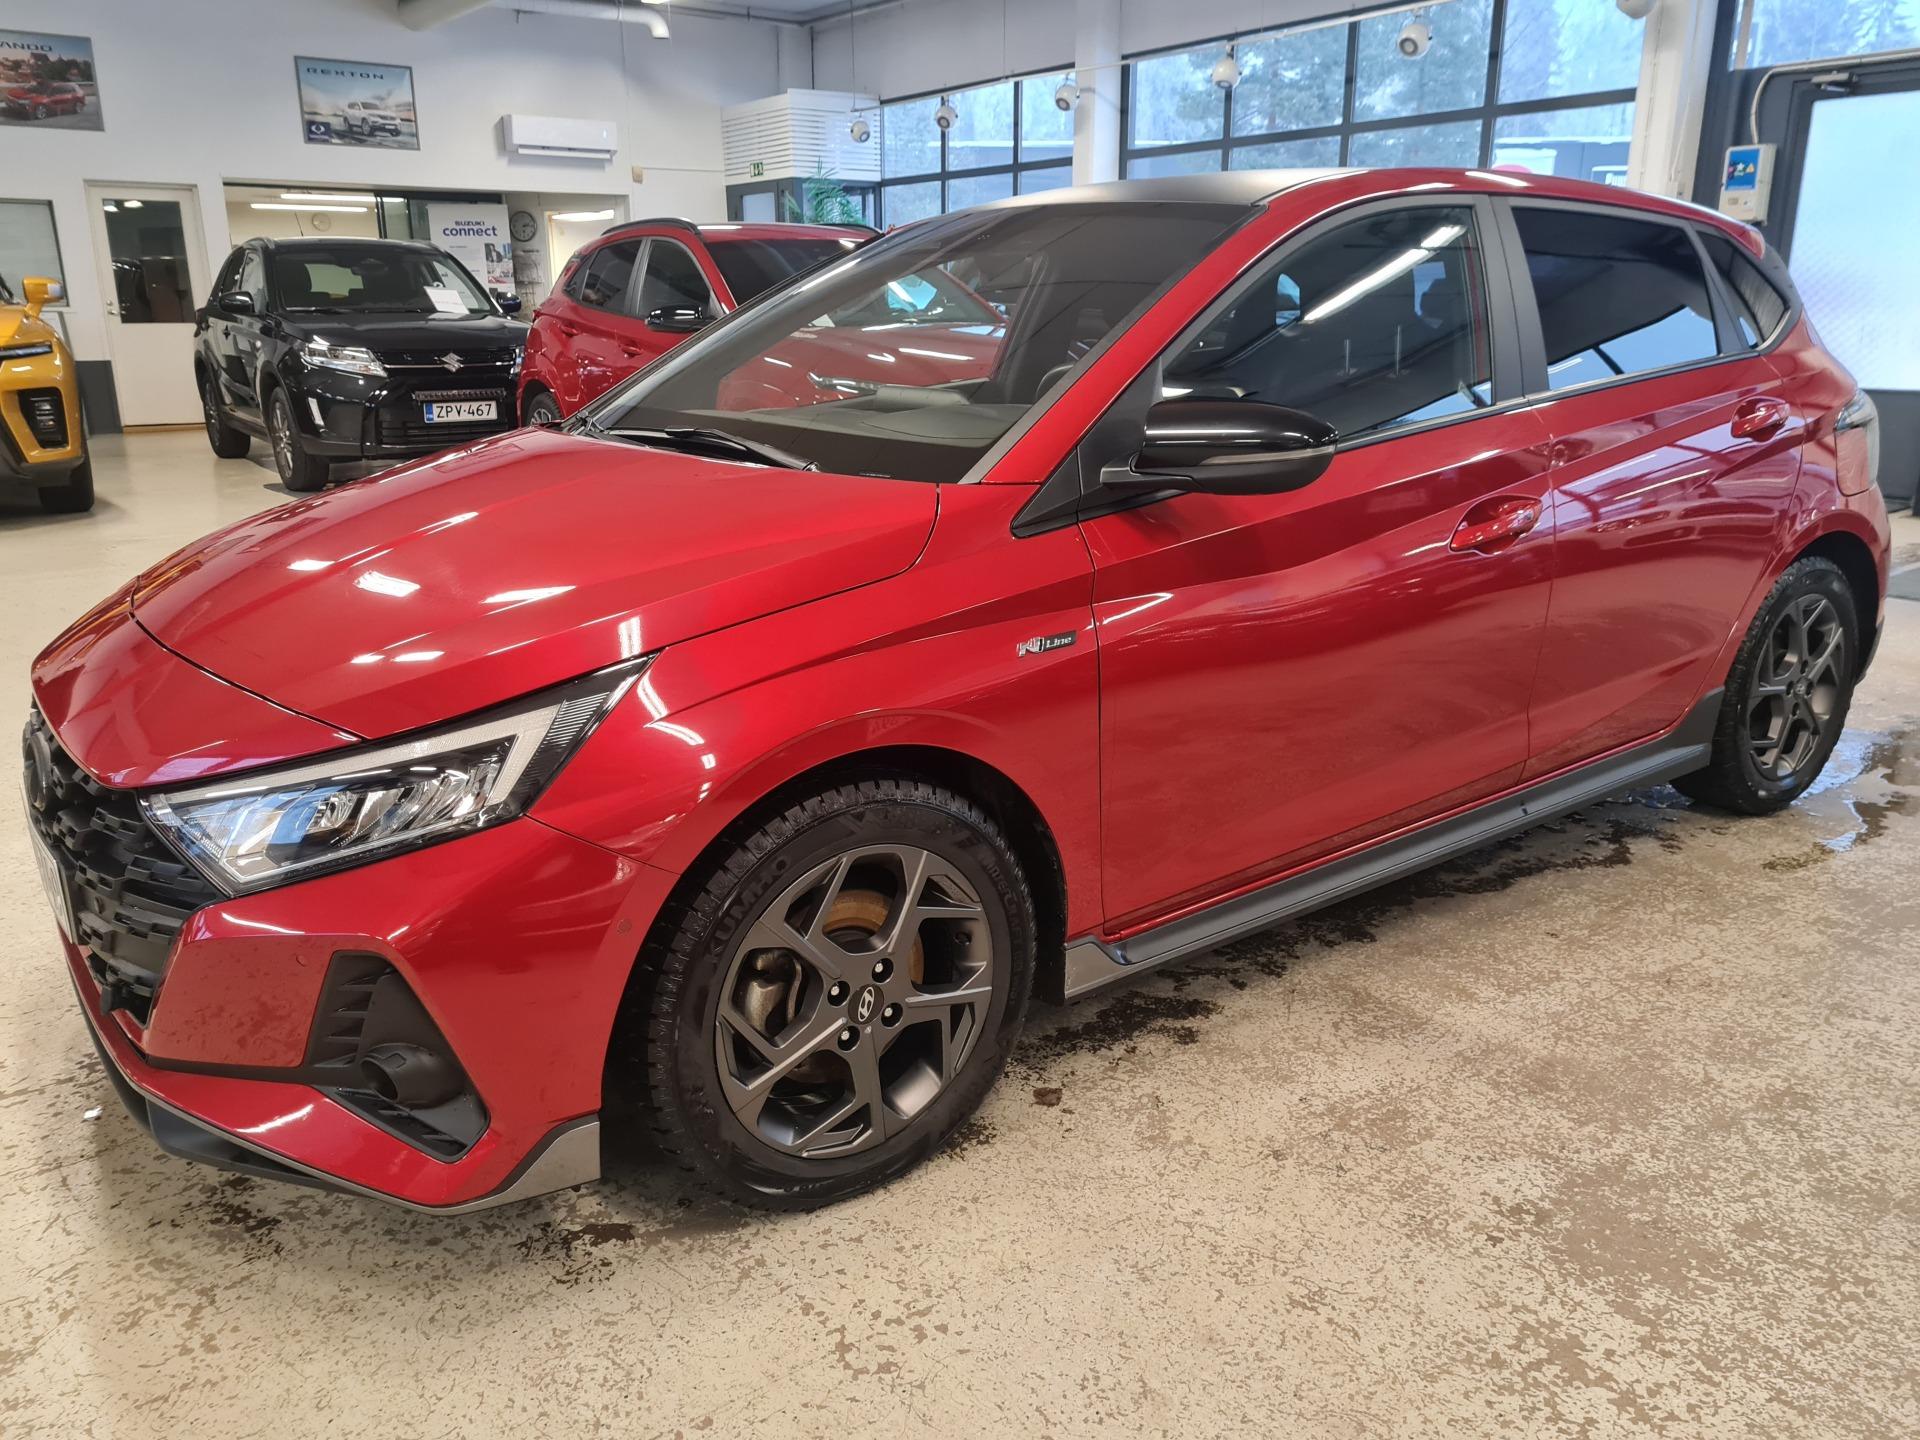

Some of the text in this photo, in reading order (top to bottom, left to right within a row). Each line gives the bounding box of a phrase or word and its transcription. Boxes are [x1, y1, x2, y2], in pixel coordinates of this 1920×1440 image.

[306, 67, 384, 80] REXTON
[443, 226, 498, 237] connect
[436, 403, 492, 419] ZPV-467
[1046, 636, 1072, 648] Line
[705, 854, 791, 958] KUMHO
